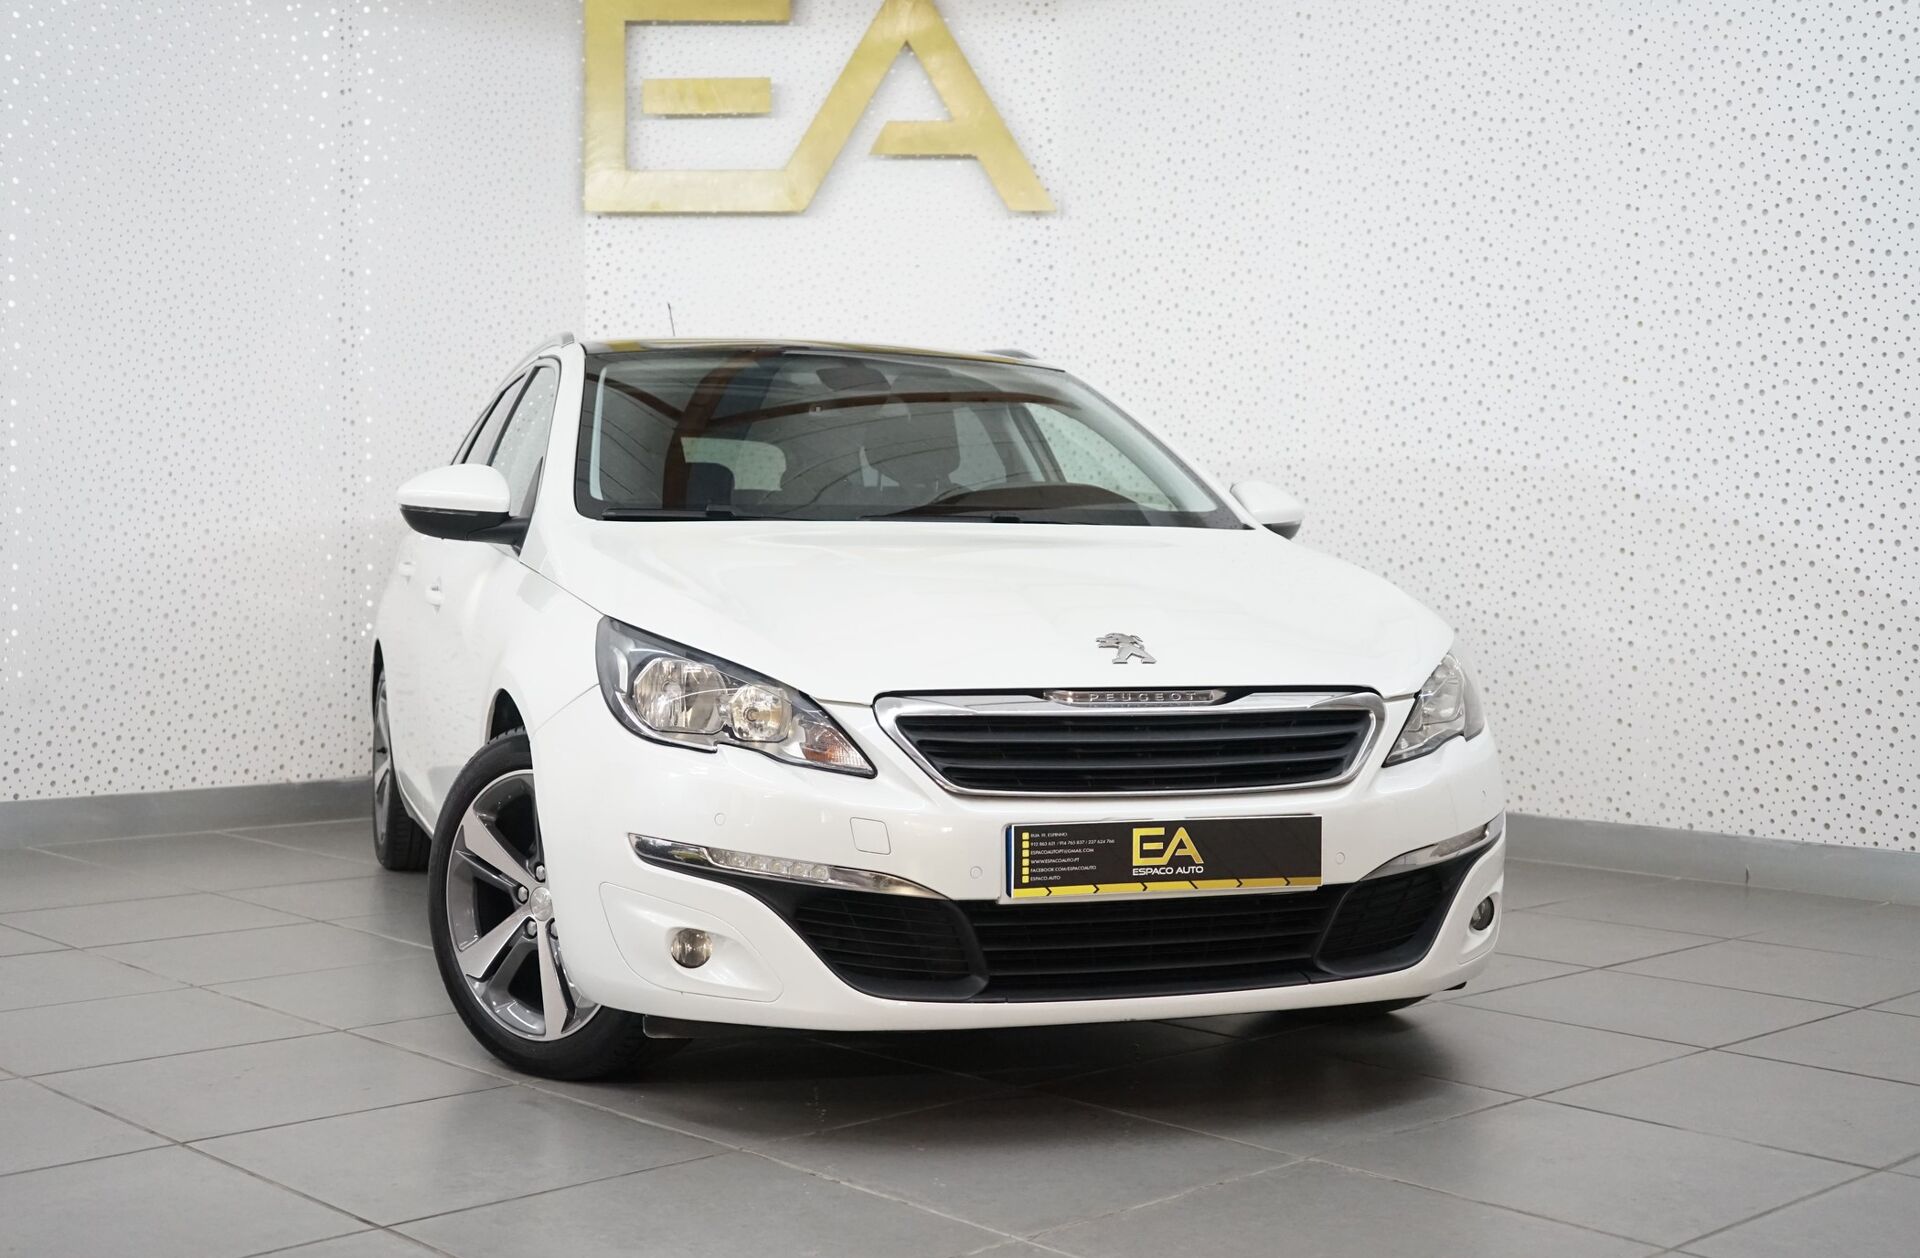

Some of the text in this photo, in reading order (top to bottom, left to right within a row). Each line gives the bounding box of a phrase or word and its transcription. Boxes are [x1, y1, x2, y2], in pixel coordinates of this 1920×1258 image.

[585, 0, 1056, 212] EA
[1090, 693, 1196, 702] PEUGEOT
[1132, 826, 1204, 866] EA
[1132, 866, 1204, 876] ESPACO AUTO
